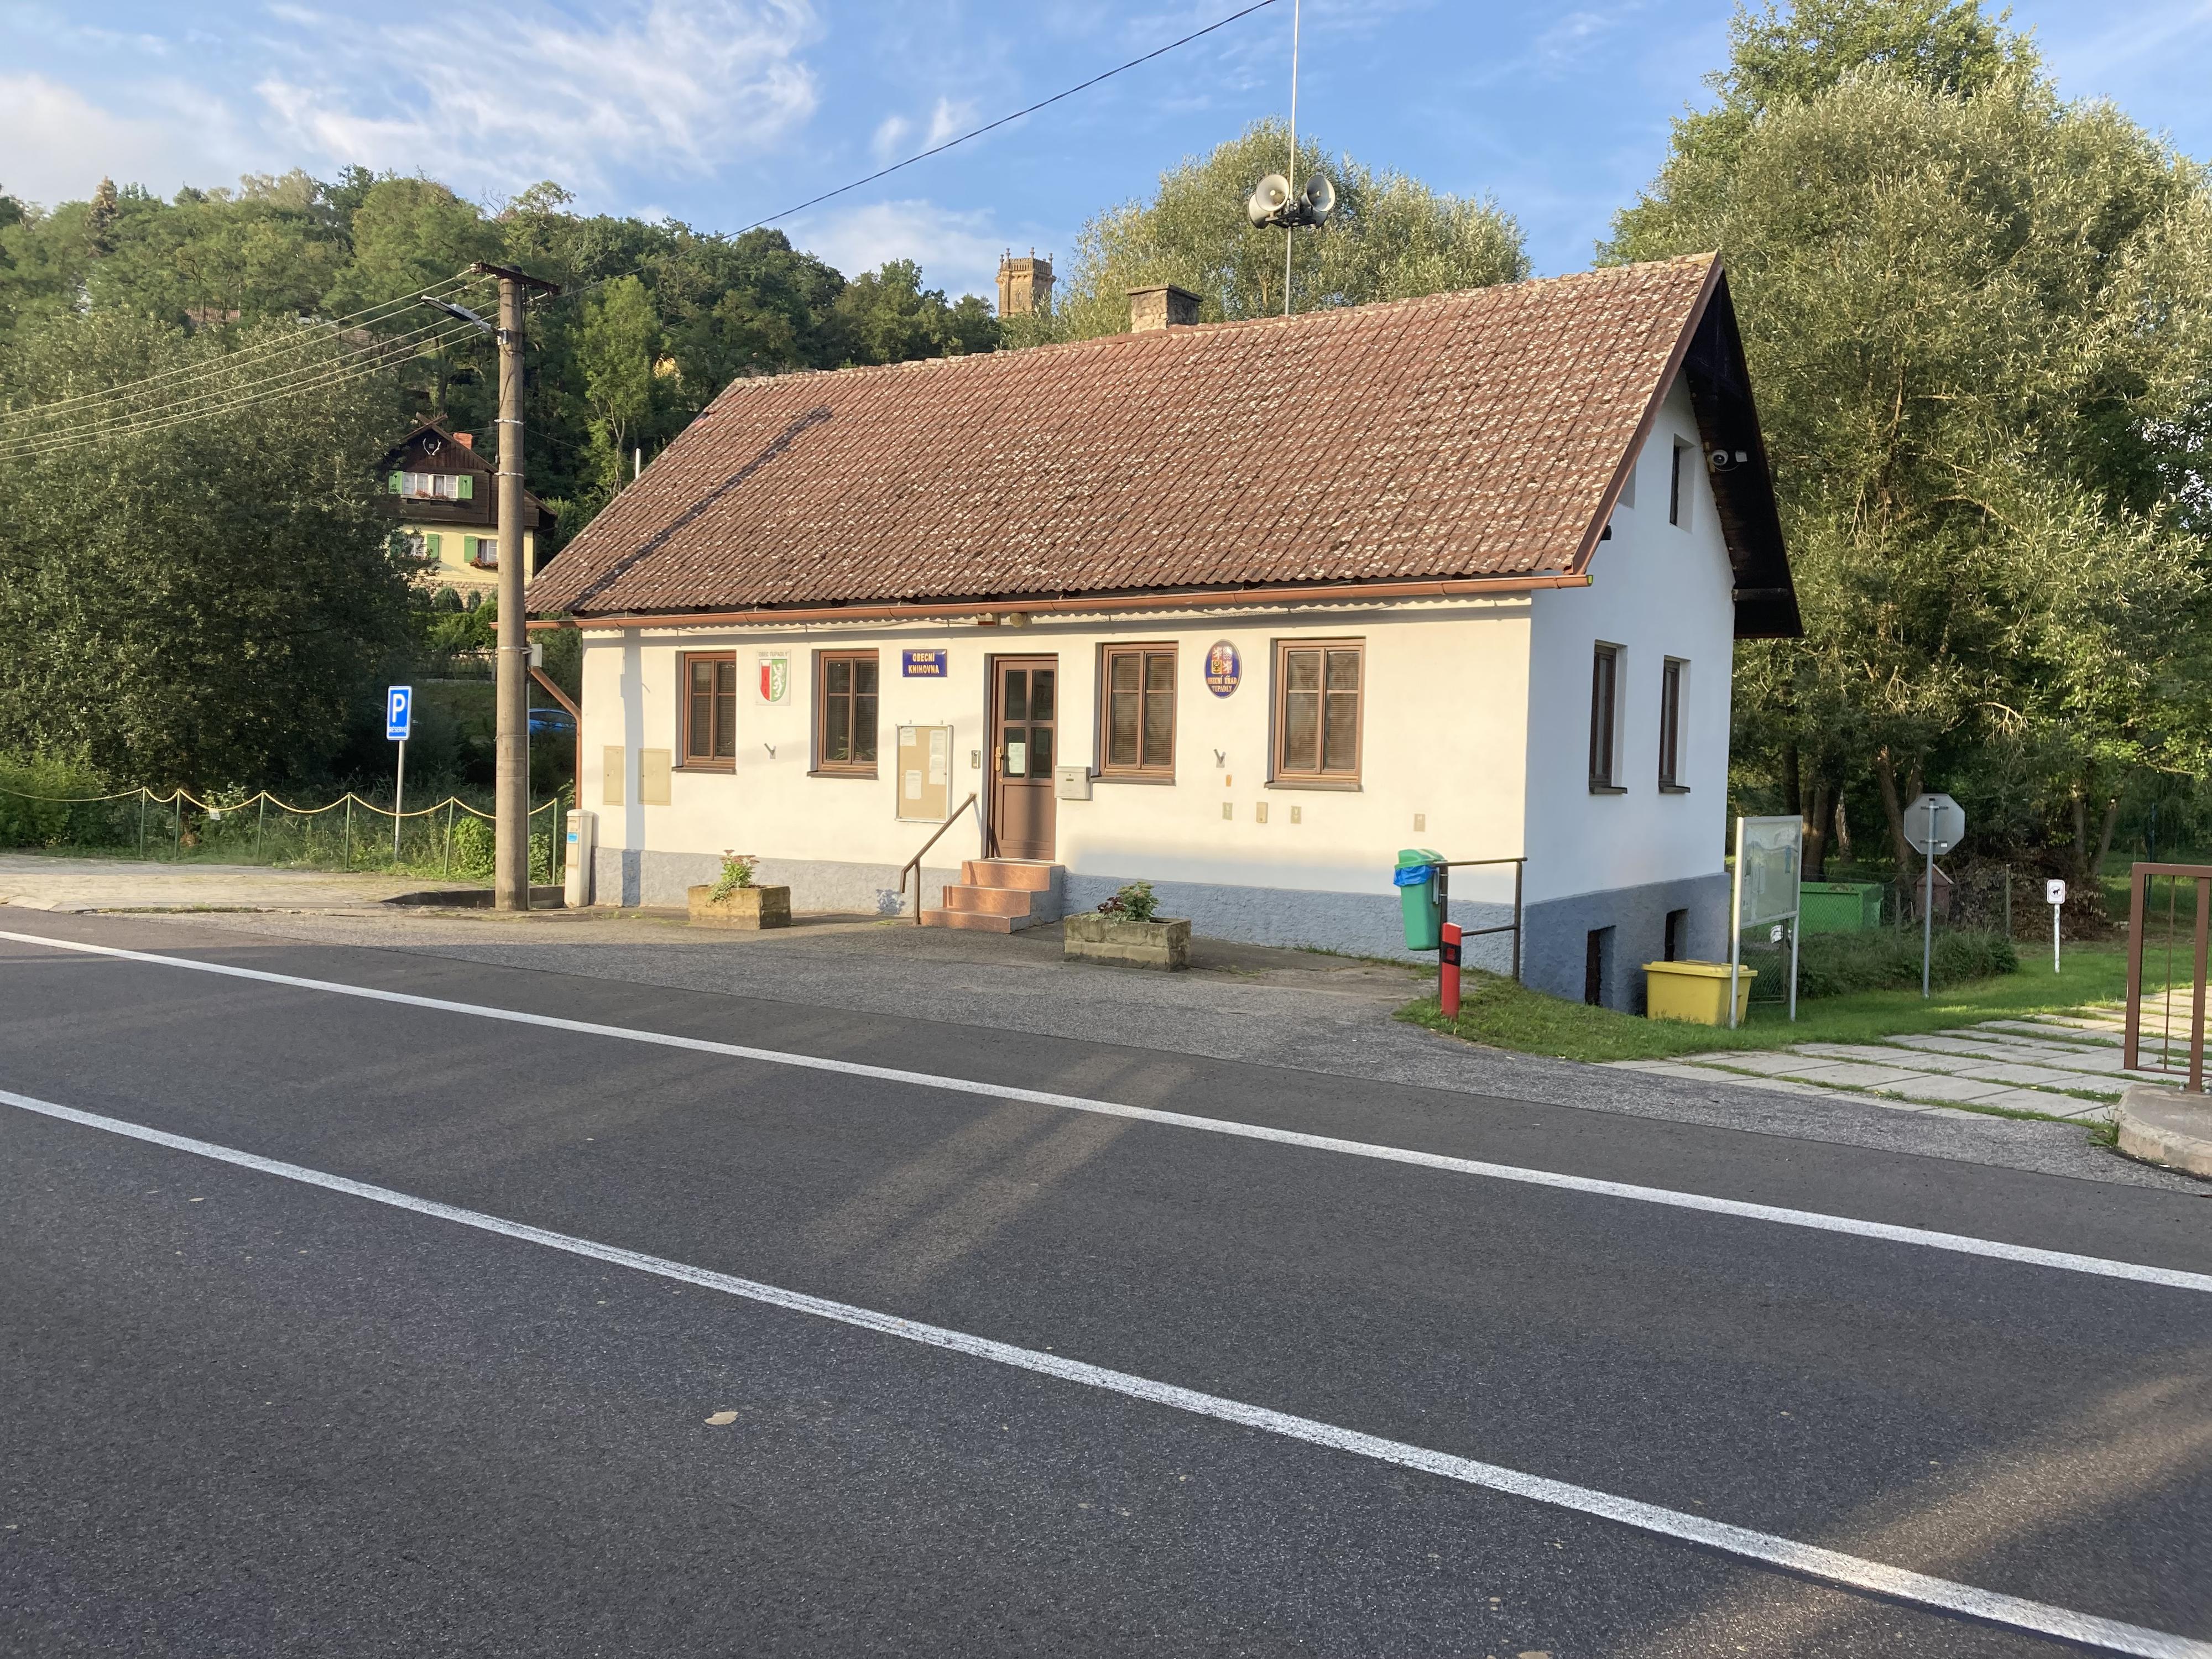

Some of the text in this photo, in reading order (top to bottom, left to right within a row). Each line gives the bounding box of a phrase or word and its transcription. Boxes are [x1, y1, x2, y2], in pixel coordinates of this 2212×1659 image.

[912, 652, 935, 662] OBECNÍ
[908, 665, 940, 674] KNIHOVNA
[392, 693, 405, 723] P
